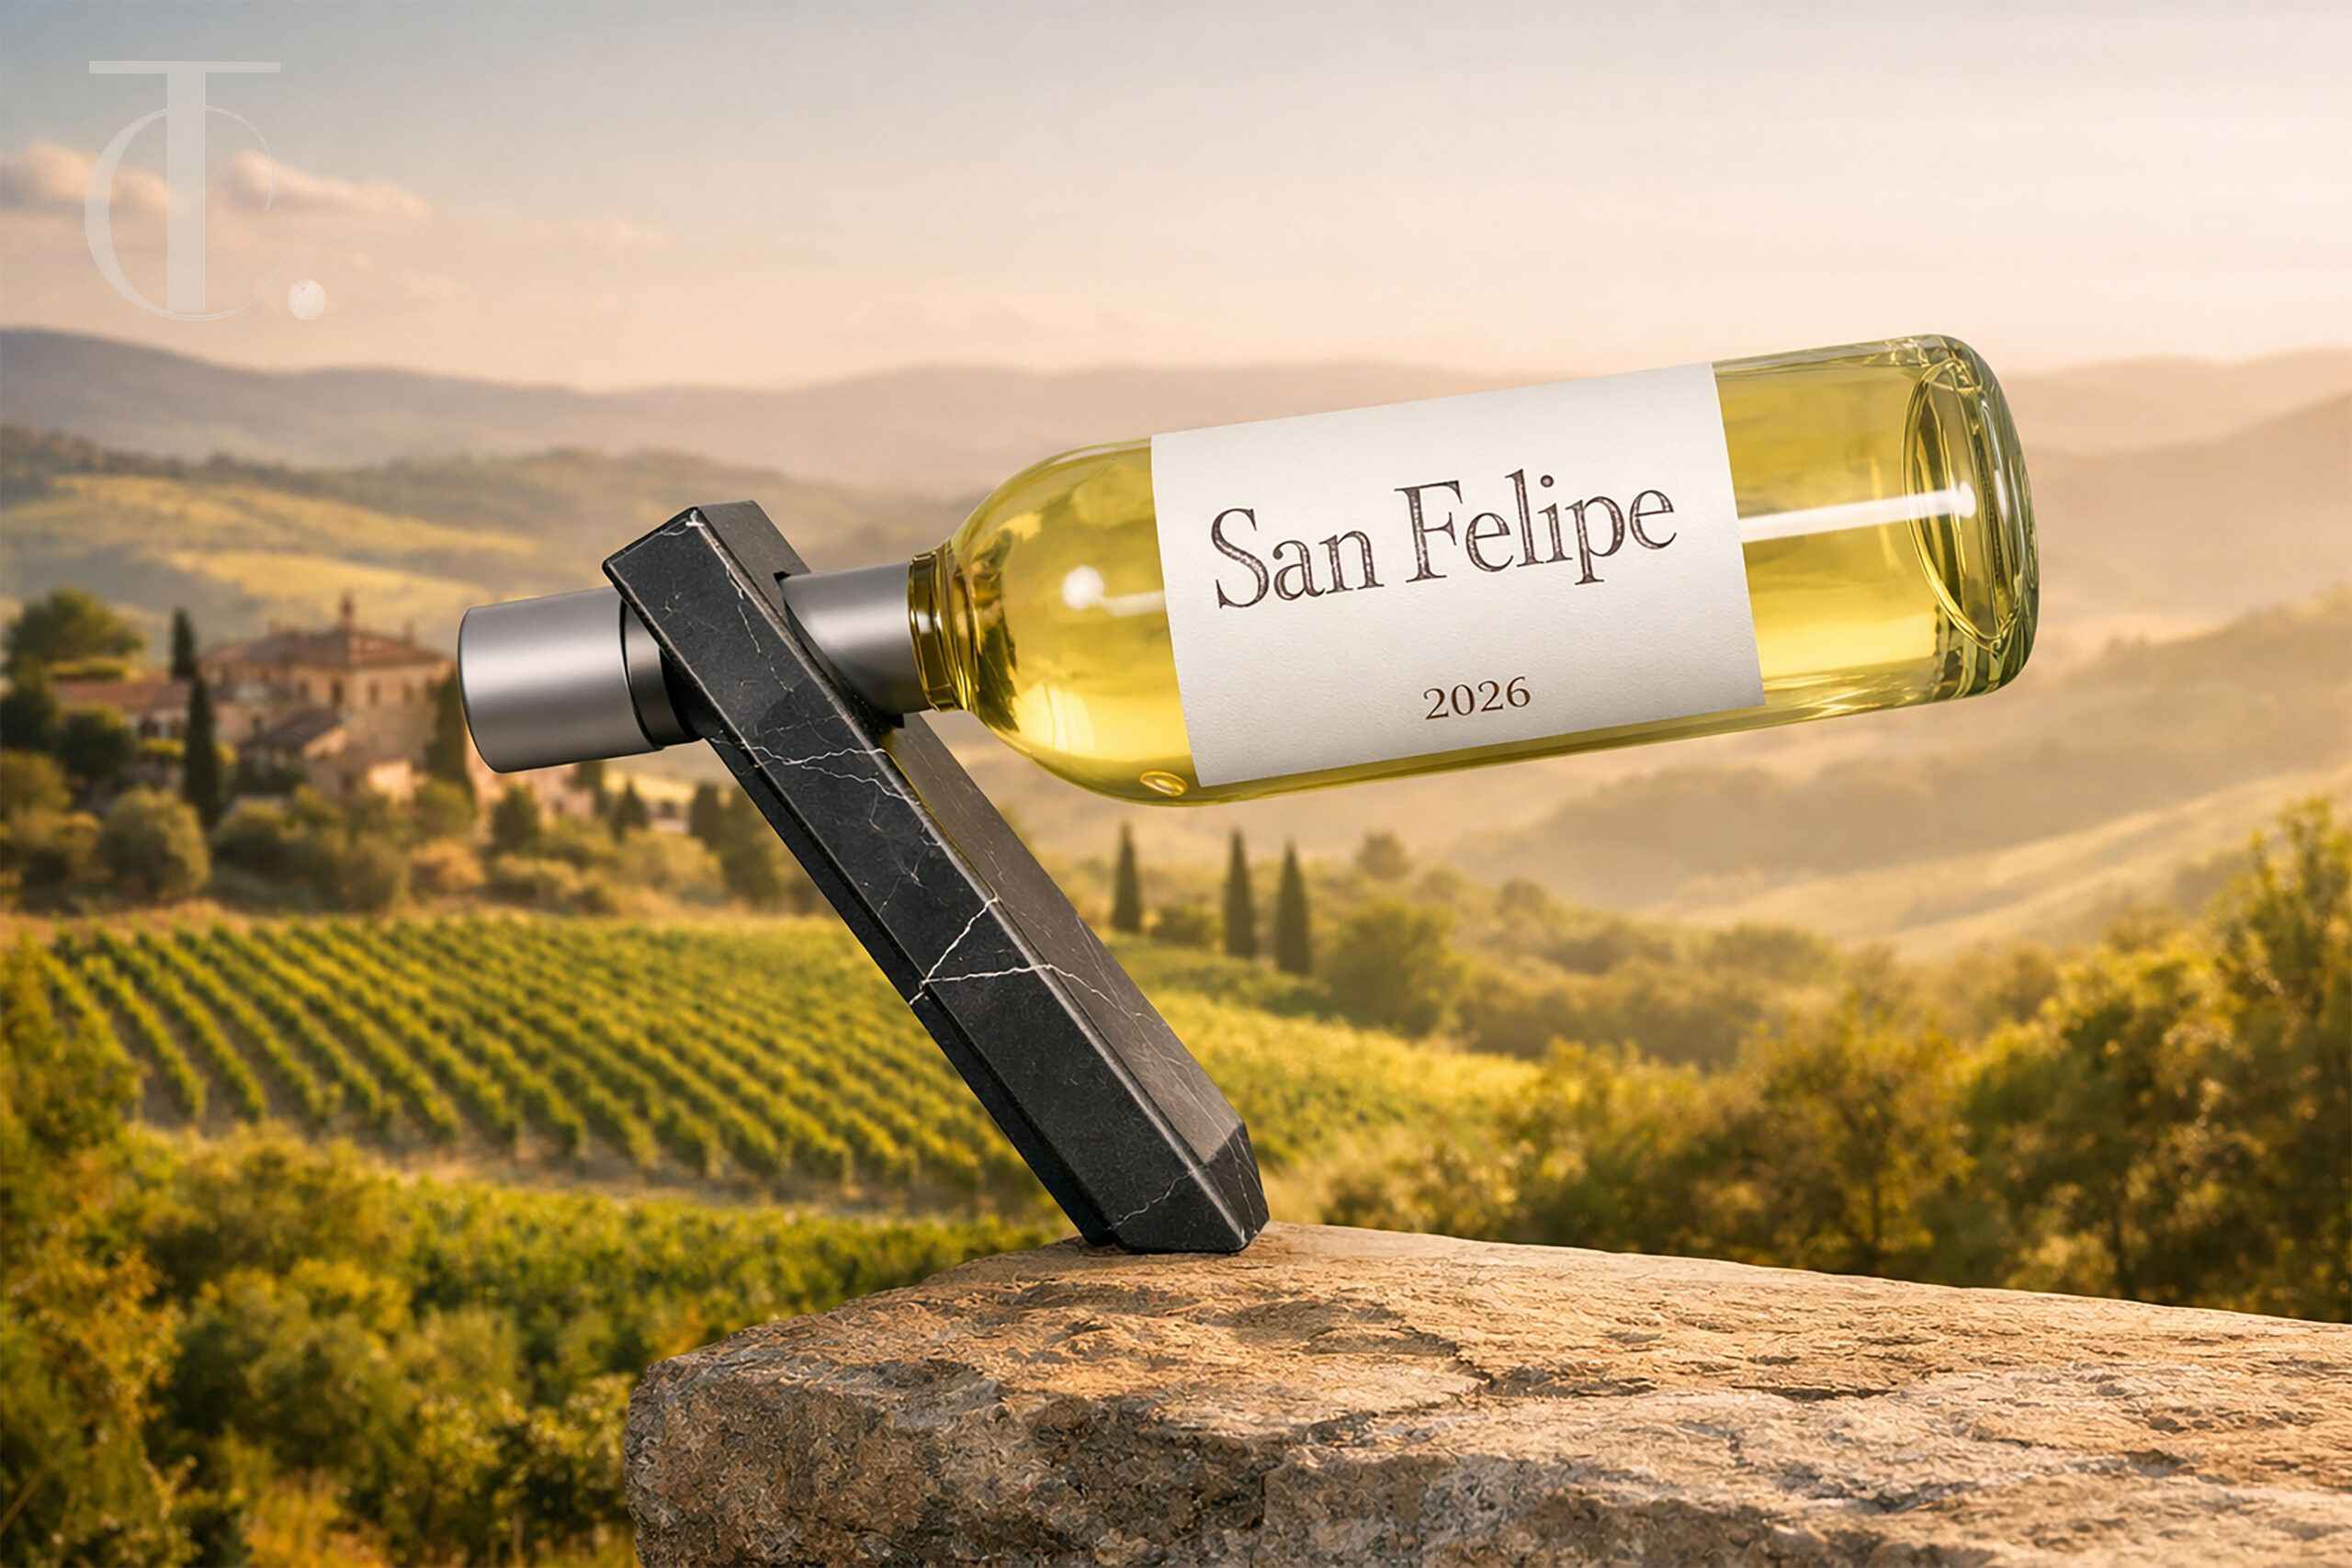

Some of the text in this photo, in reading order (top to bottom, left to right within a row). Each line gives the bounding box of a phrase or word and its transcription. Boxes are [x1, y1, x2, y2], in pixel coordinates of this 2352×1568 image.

[1210, 468, 1678, 609] San Felipe
[1422, 675, 1532, 721] 2026
